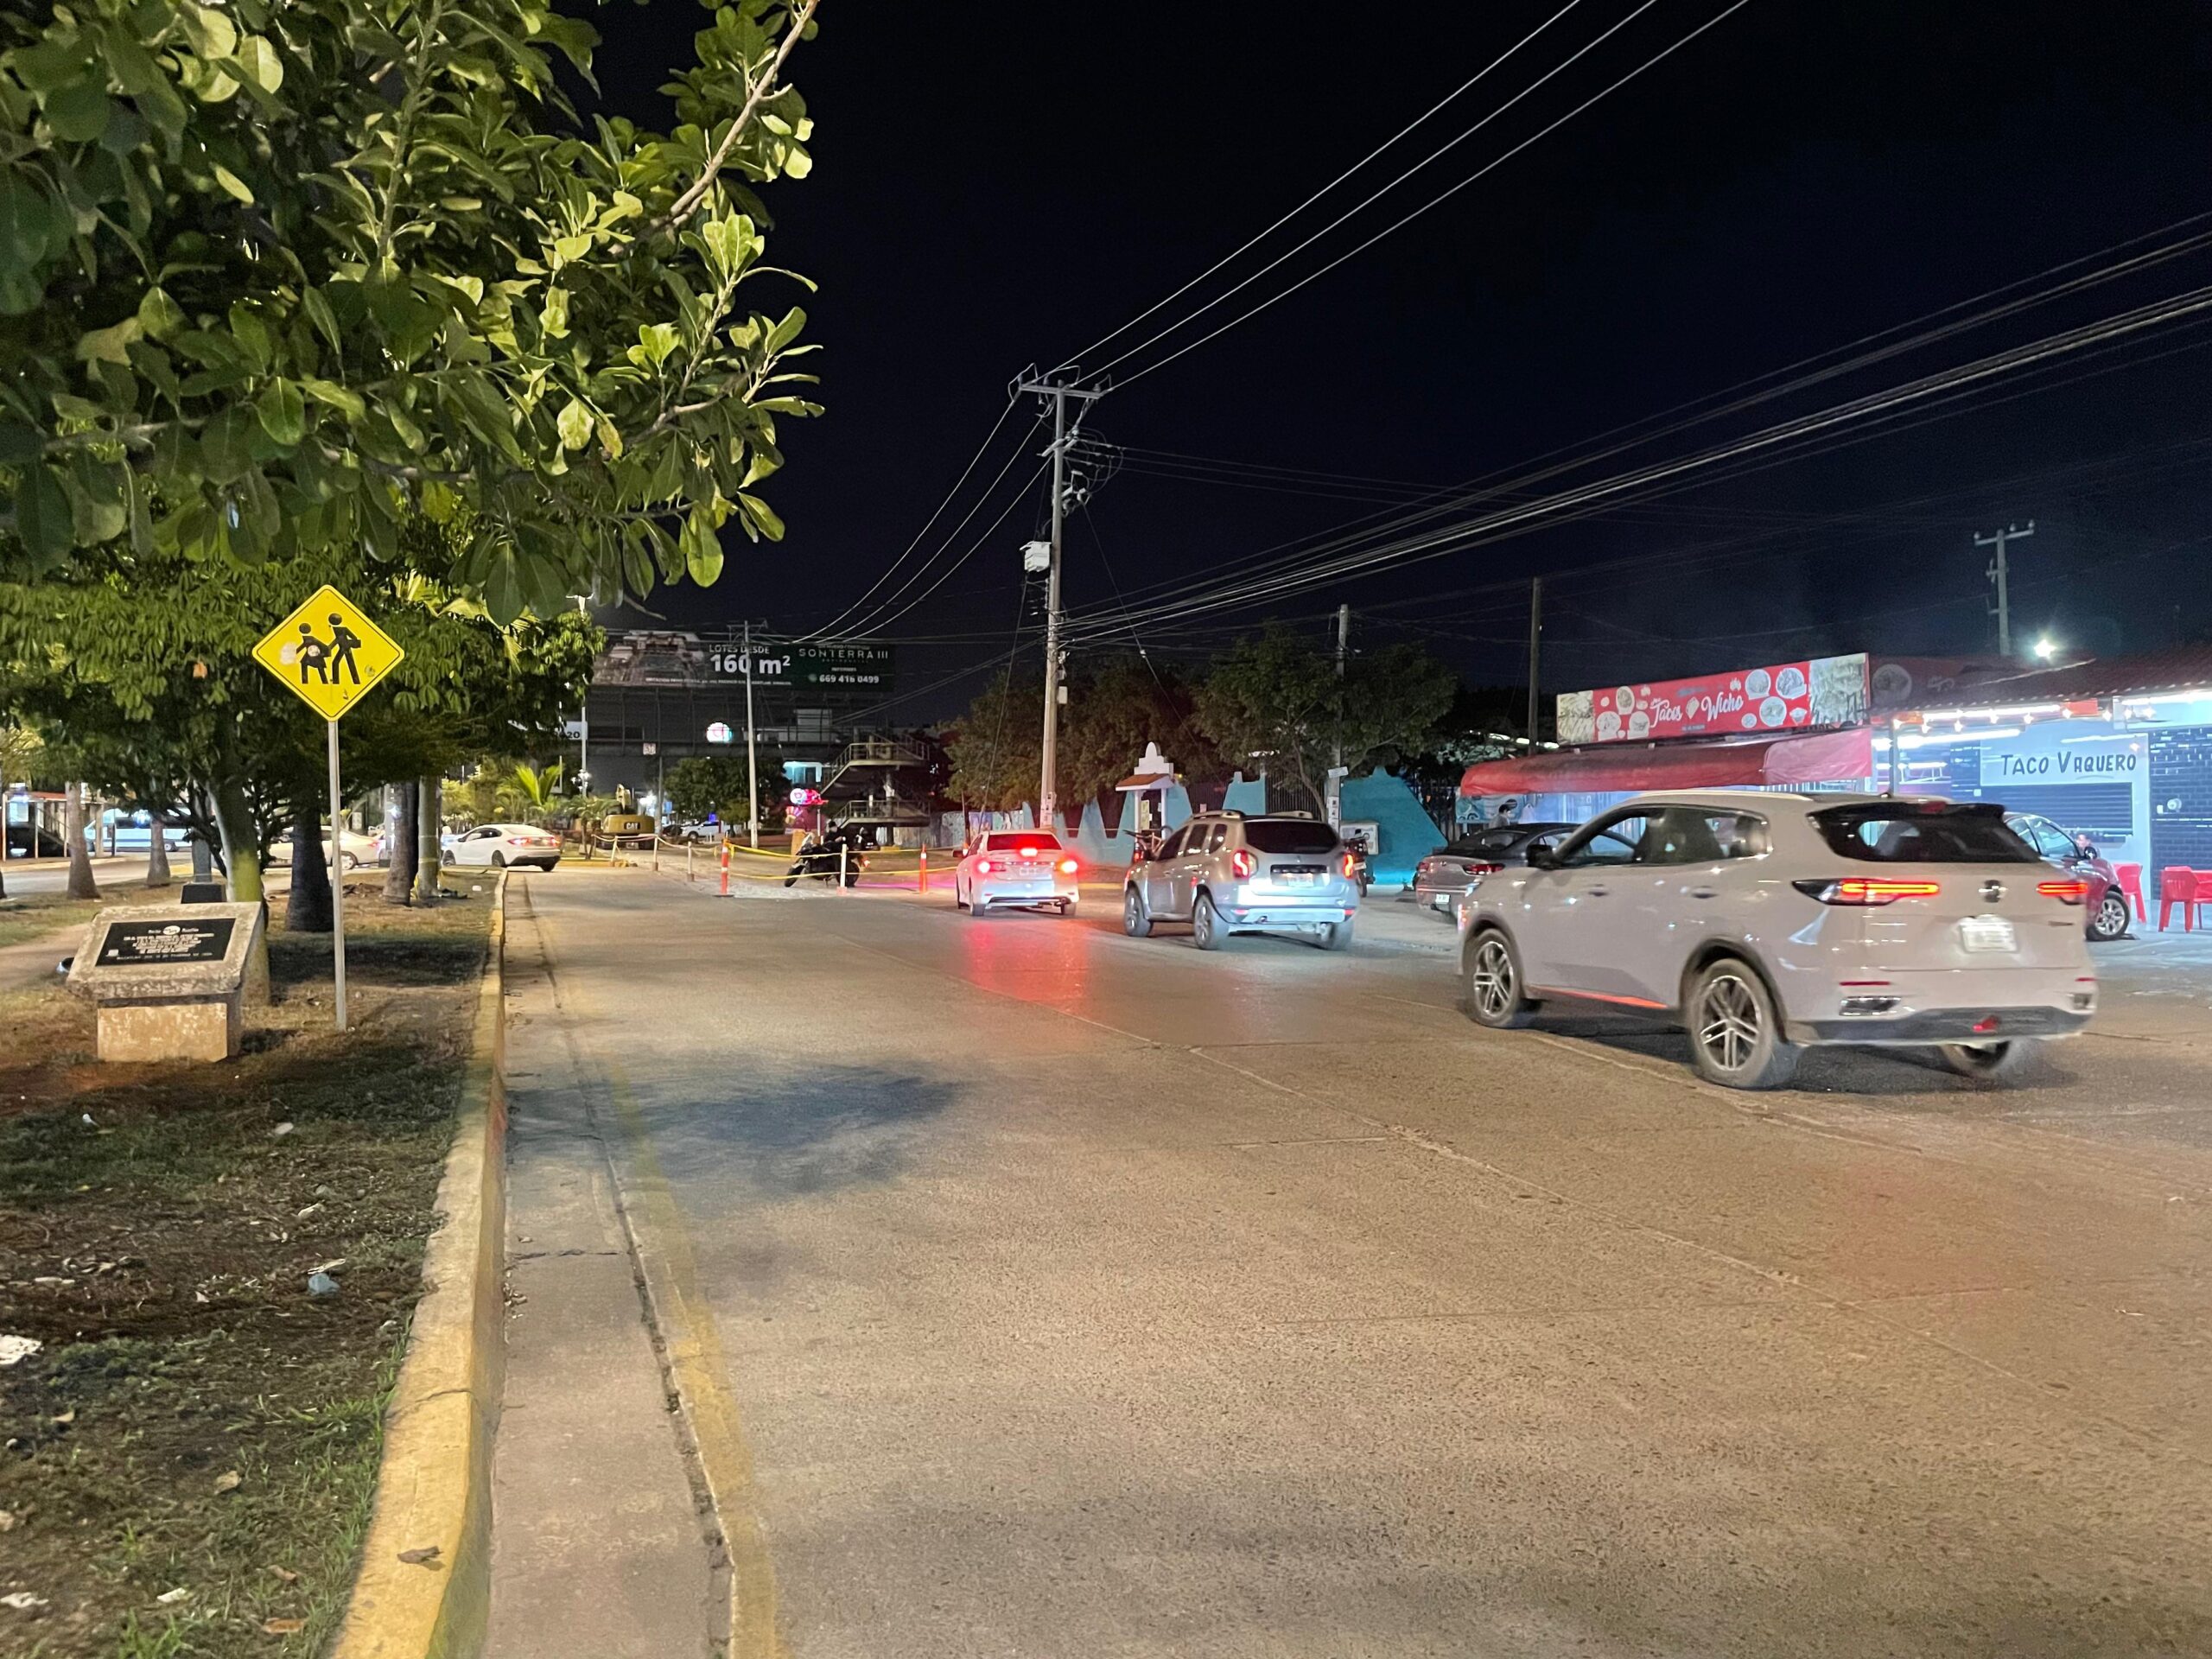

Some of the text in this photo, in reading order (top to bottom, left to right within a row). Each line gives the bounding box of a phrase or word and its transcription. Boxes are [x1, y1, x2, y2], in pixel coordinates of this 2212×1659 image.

[798, 648, 888, 659] SONTERRA III
[710, 654, 752, 673] 160
[819, 674, 836, 683] 669
[1649, 698, 1683, 728] Tacos
[2000, 751, 2137, 776] TACO VAQUERO
